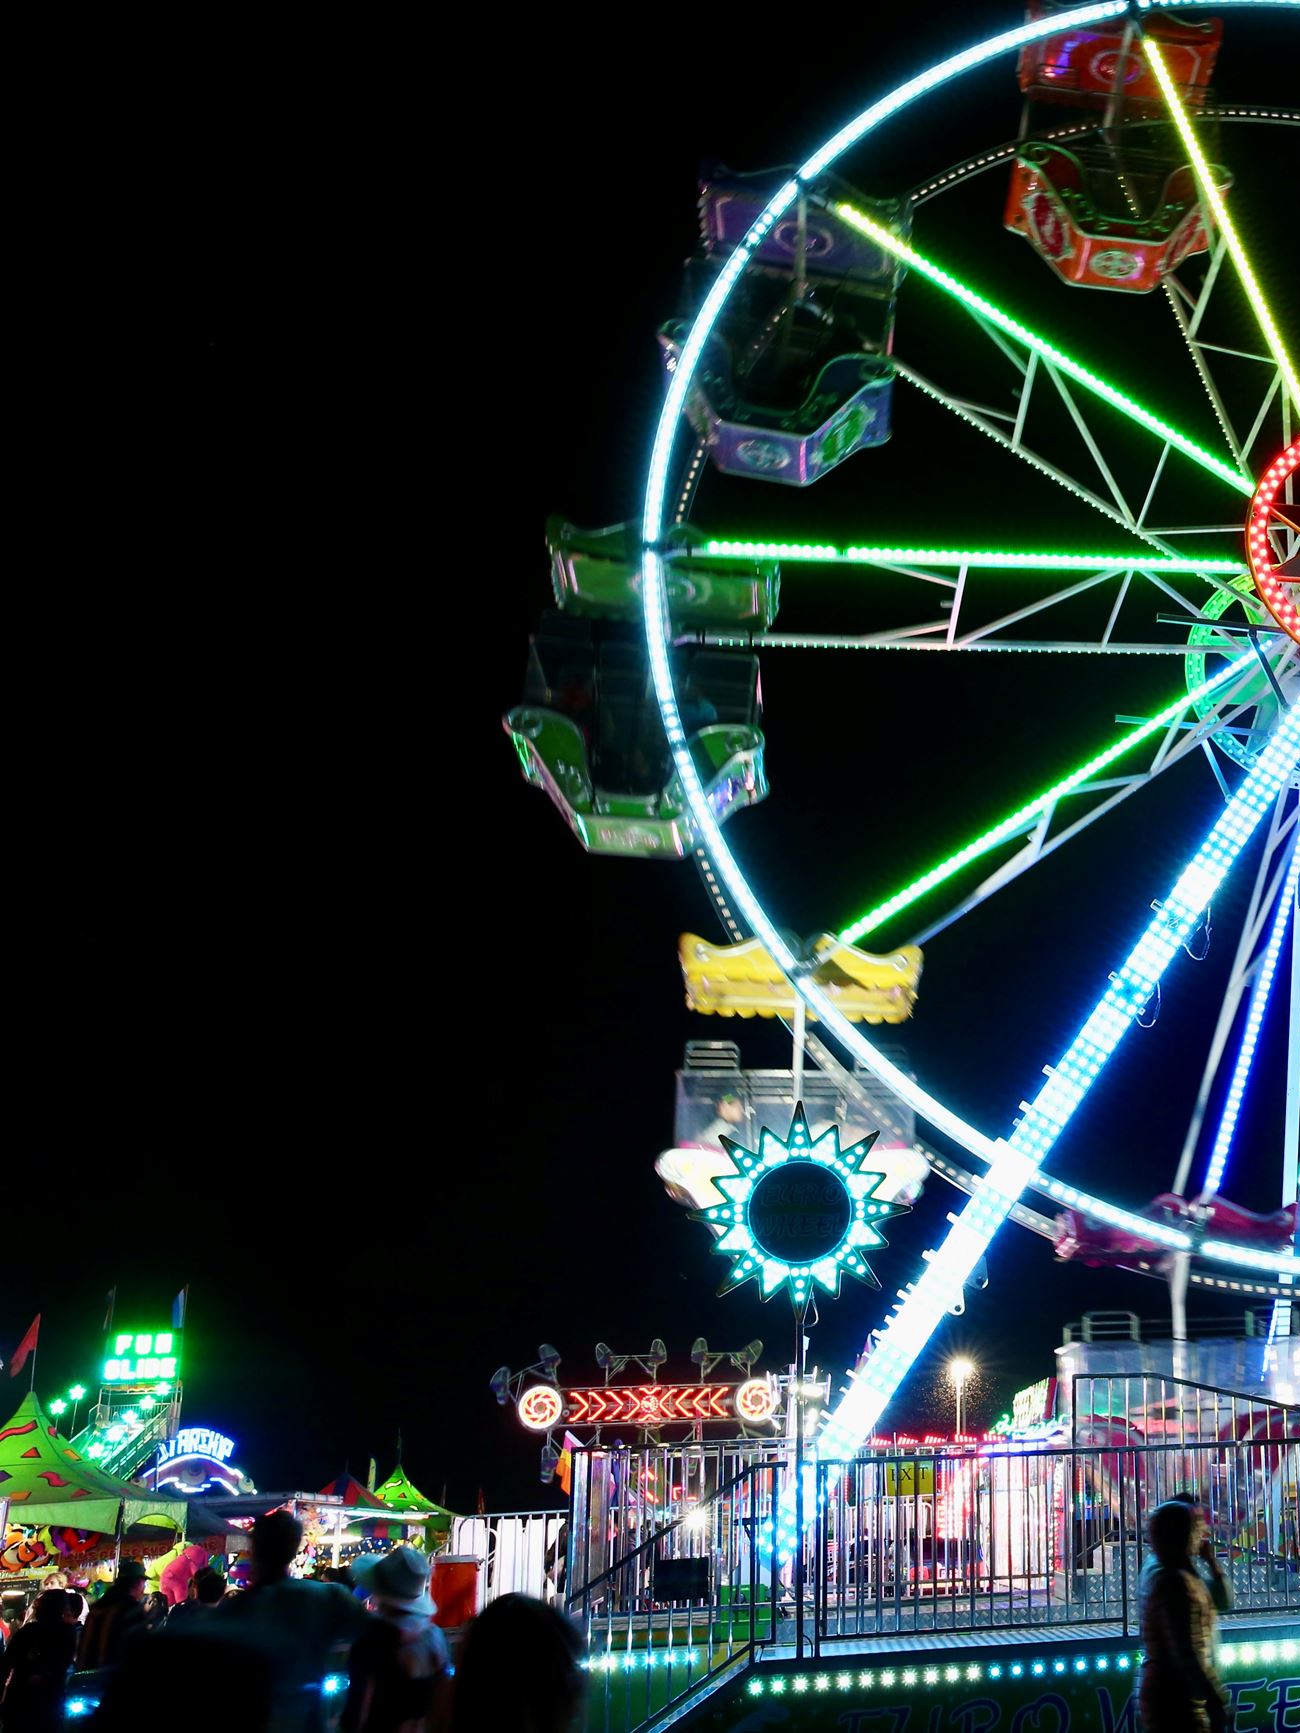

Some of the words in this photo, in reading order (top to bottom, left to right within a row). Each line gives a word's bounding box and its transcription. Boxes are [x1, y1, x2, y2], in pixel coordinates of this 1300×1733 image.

[115, 1333, 173, 1356] FUN
[104, 1358, 177, 1380] SLIDE
[890, 1466, 928, 1482] XT
